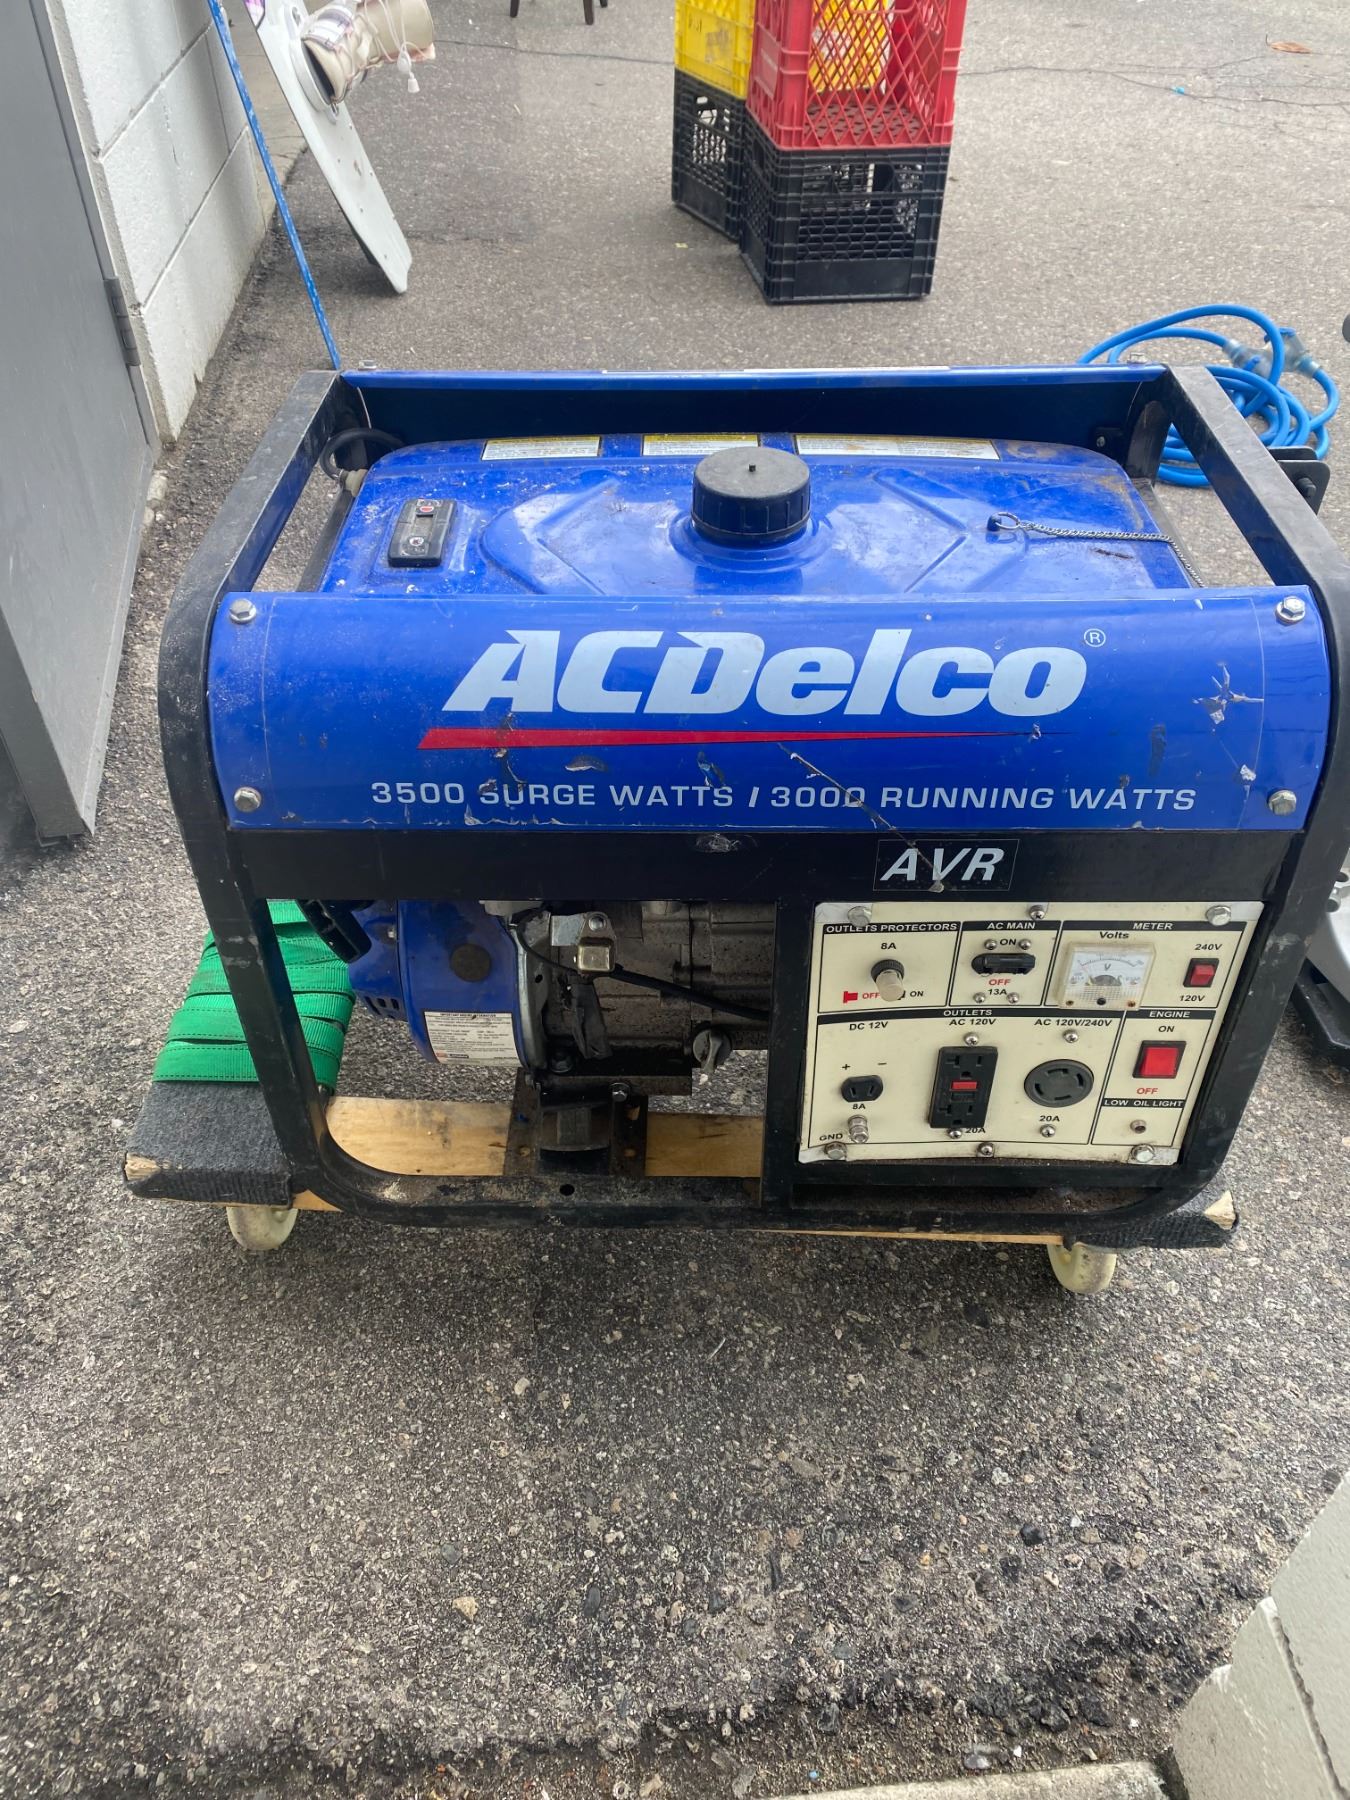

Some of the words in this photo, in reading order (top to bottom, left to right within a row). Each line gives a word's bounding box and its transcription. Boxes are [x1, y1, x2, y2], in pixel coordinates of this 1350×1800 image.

[441, 628, 1088, 718] ACDelco
[371, 782, 465, 804] 3500
[479, 784, 596, 806] SURGE
[609, 784, 733, 807] WATTS
[770, 786, 866, 809] 3000
[880, 786, 1054, 810] RUNNING
[1069, 788, 1197, 811] WATTS
[879, 847, 1005, 882] AVR
[826, 924, 878, 934] OUTLETS
[880, 922, 958, 932] PROTECTORS
[987, 922, 1006, 930] AC
[1007, 922, 1036, 930] MAIN
[1132, 922, 1173, 930] METER
[1099, 931, 1129, 939] Volts
[880, 942, 897, 950] 8A
[999, 938, 1017, 946] ON
[1194, 943, 1222, 951] 240V
[988, 978, 1011, 986] OFF
[862, 992, 881, 1000] OFF
[909, 990, 924, 998] ON
[988, 988, 1007, 996] 13A
[1179, 994, 1205, 1002] 120V
[943, 1009, 993, 1017] OUTLETS
[1149, 1010, 1190, 1018] ENGINE
[849, 1022, 865, 1031] DC
[869, 1021, 888, 1029] 12V
[948, 1018, 966, 1026] AC
[969, 1018, 997, 1026] 120V
[1033, 1018, 1051, 1026] AC
[1055, 1018, 1113, 1027] 120V/240V
[1158, 1025, 1175, 1033] ON
[1136, 1087, 1158, 1095] OFF
[819, 1133, 843, 1141] GND
